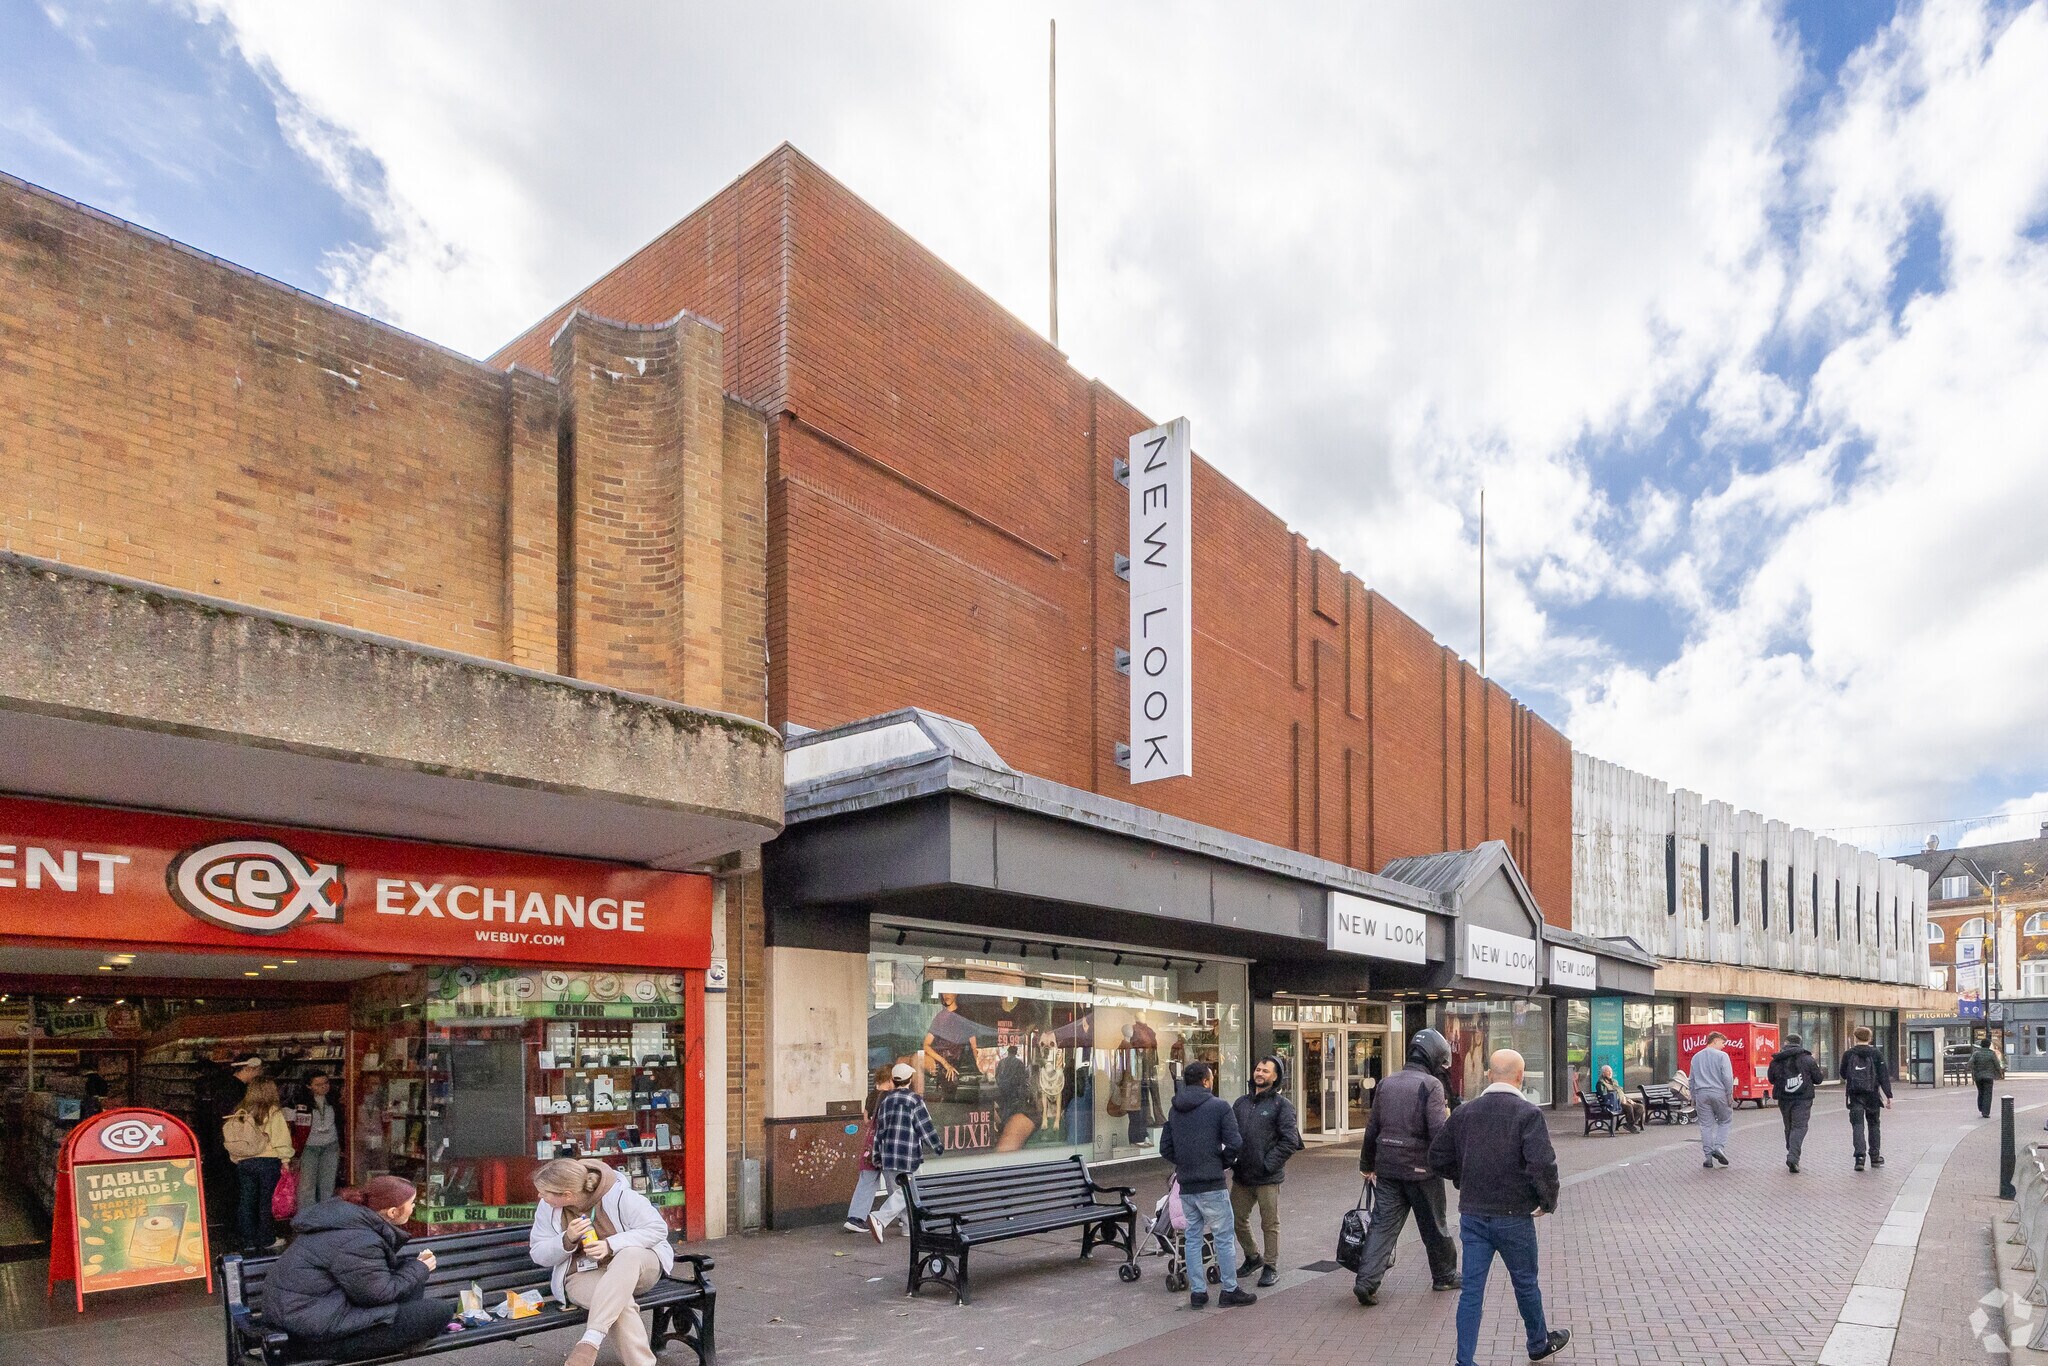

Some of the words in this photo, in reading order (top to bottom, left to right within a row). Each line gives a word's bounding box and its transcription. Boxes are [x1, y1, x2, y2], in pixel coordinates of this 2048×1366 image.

[1144, 436, 1167, 567] NEW
[1144, 607, 1168, 769] LOOK
[376, 878, 645, 932] EXCHANGE
[475, 930, 565, 946] WEBUY.COM
[1339, 912, 1377, 936] NEW
[1385, 923, 1424, 946] LOOK
[1472, 943, 1500, 963] NEW
[1505, 950, 1535, 970] LOOK
[1556, 959, 1574, 974] NEW
[1577, 964, 1596, 977] LOOK
[555, 1003, 606, 1017] GAMING
[633, 1005, 678, 1018] PHONES
[1683, 1035, 1707, 1052] Wild
[969, 1111, 979, 1123] TO
[980, 1111, 990, 1123] BE
[943, 1123, 991, 1150] LUXE
[87, 1167, 168, 1189] TABLET
[101, 1205, 149, 1222] SAVE
[433, 1208, 454, 1222] BUY
[464, 1208, 488, 1221] SELL
